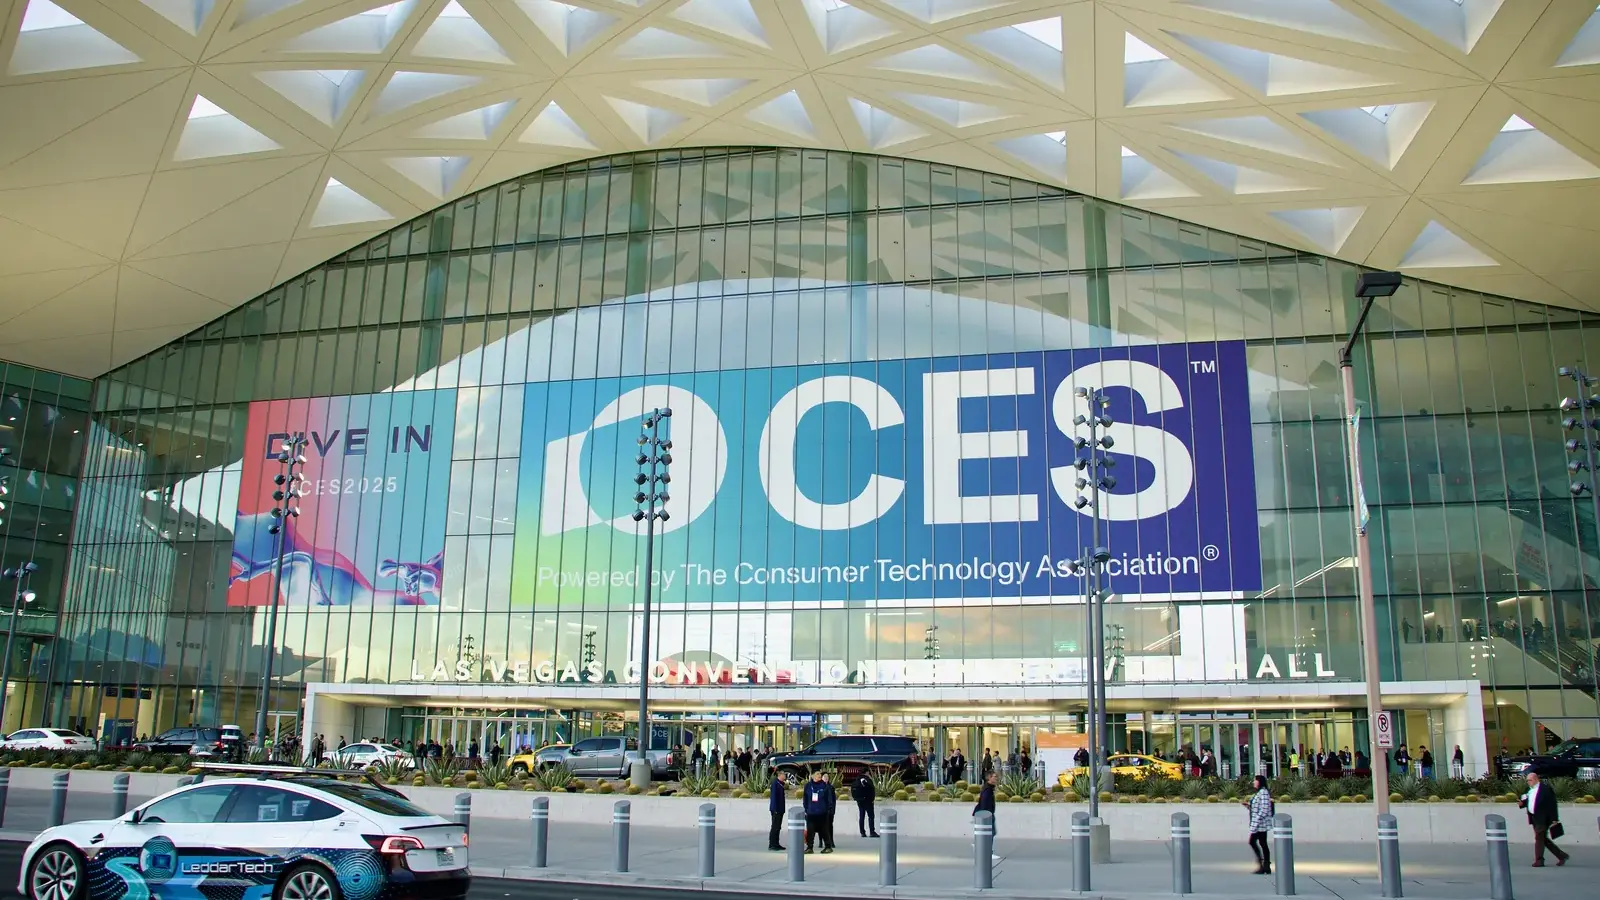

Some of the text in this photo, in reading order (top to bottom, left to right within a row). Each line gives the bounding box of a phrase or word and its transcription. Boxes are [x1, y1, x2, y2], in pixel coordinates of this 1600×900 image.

[266, 424, 430, 459] DIVE IN
[759, 360, 1194, 530] CES
[538, 565, 639, 588] Powered
[680, 563, 727, 586] The
[734, 562, 870, 584] Consumer
[874, 556, 1030, 585] Technology
[410, 659, 472, 681] LAS
[490, 660, 603, 682] VEGAS
[181, 862, 273, 873] LeddarTech
